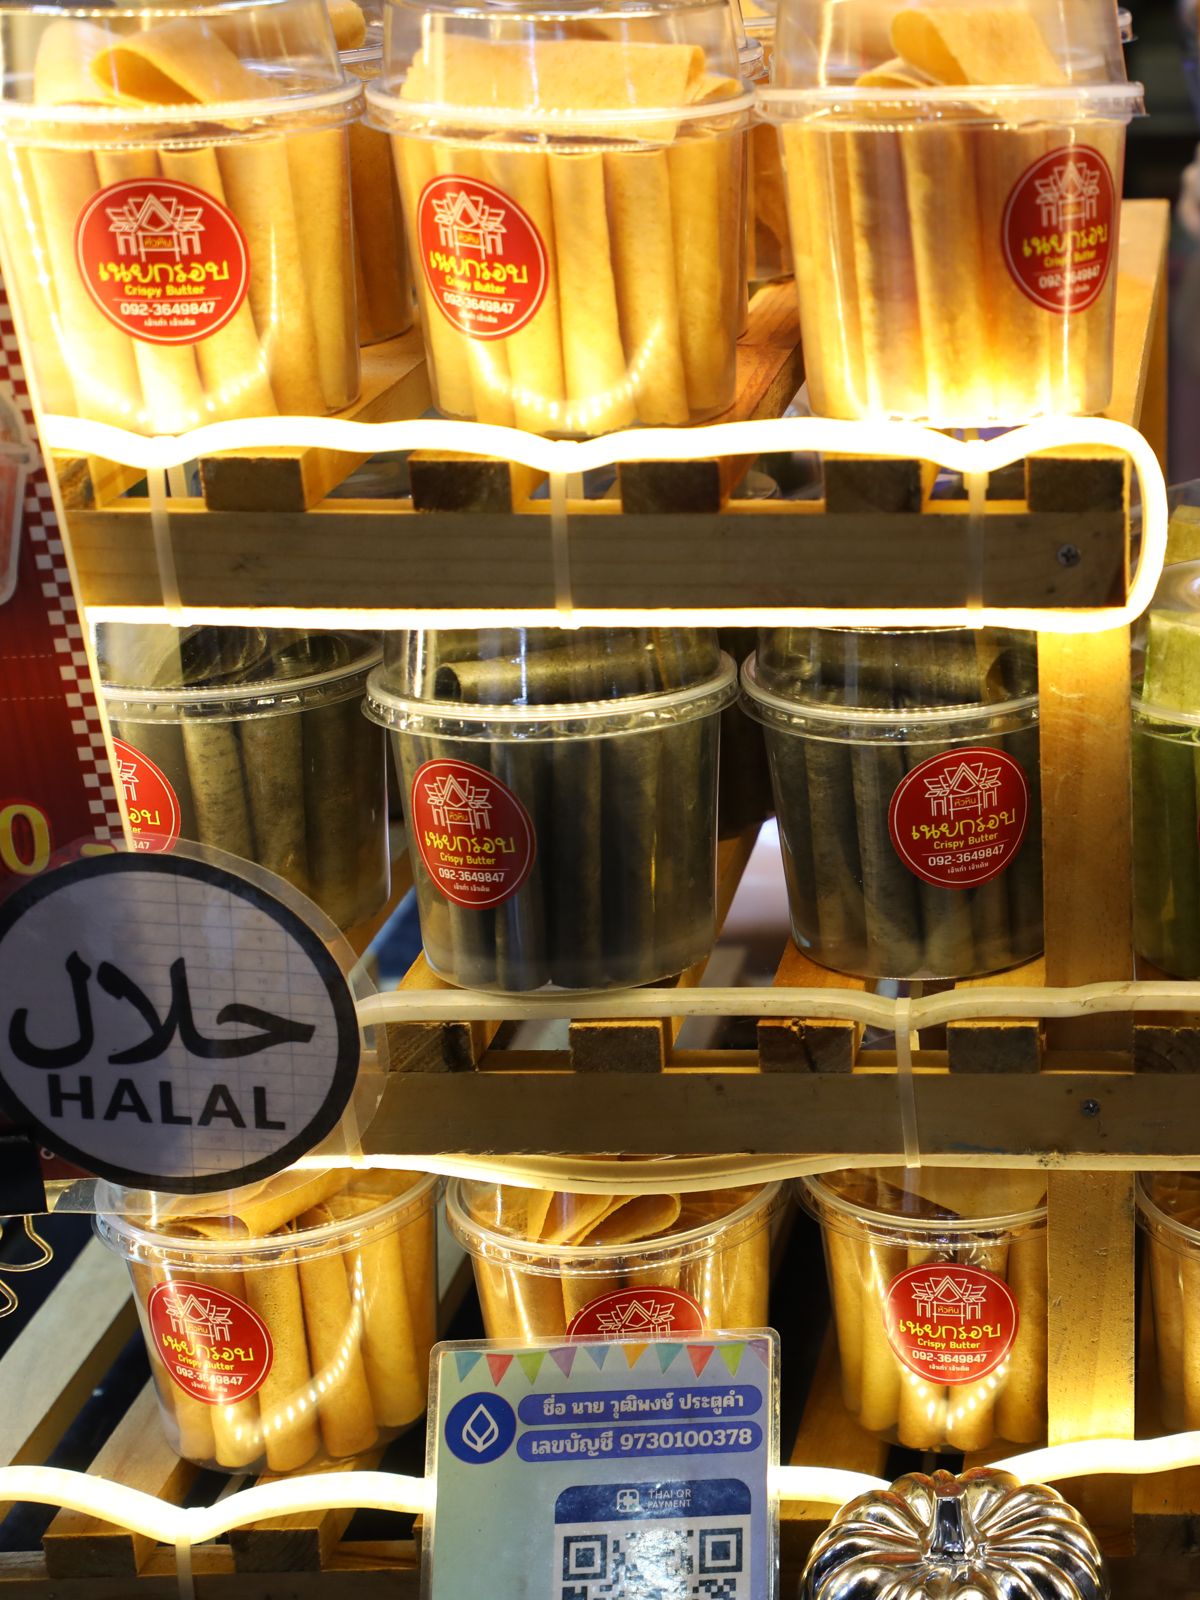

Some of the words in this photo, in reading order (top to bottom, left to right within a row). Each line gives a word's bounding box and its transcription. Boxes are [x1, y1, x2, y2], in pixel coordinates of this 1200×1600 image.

[99, 260, 229, 283] เนยกรอบ
[430, 251, 528, 283] เนยกรอบ
[124, 285, 161, 298] Crispy
[166, 286, 206, 295] Butter
[474, 282, 506, 294] Butter
[120, 301, 215, 316] 092-3649847
[444, 292, 515, 314] 092-3649847
[912, 808, 1016, 840] เนยกรอบ
[425, 831, 515, 853] เนยกรอบ
[934, 839, 964, 850] Crispy
[968, 832, 998, 845] Butter
[440, 852, 464, 865] Crispy
[467, 856, 496, 865] Butter
[928, 845, 1004, 866] 092-3649847
[439, 868, 505, 882] 092-3649847
[9, 950, 316, 1070] حلال
[48, 1073, 286, 1131] HALAL
[899, 1320, 1000, 1339] เนยกรอบ
[162, 1334, 254, 1361] เนยกรอบ
[918, 1338, 945, 1349] Crispy
[178, 1354, 202, 1368] Crispy
[913, 1351, 986, 1364] 092-3649847
[176, 1366, 243, 1385] 092-3649847
[543, 1395, 566, 1416] ชื่อ
[572, 1400, 603, 1415] นาย
[612, 1392, 674, 1419] วุฒิพงษ์
[679, 1390, 743, 1415] ประตูคำ
[532, 1431, 614, 1457] เลขบัญชี
[620, 1428, 752, 1449] 9730100378
[648, 1499, 691, 1508] PAYMENT
[649, 1489, 673, 1499] THAI
[676, 1489, 692, 1498] QR
